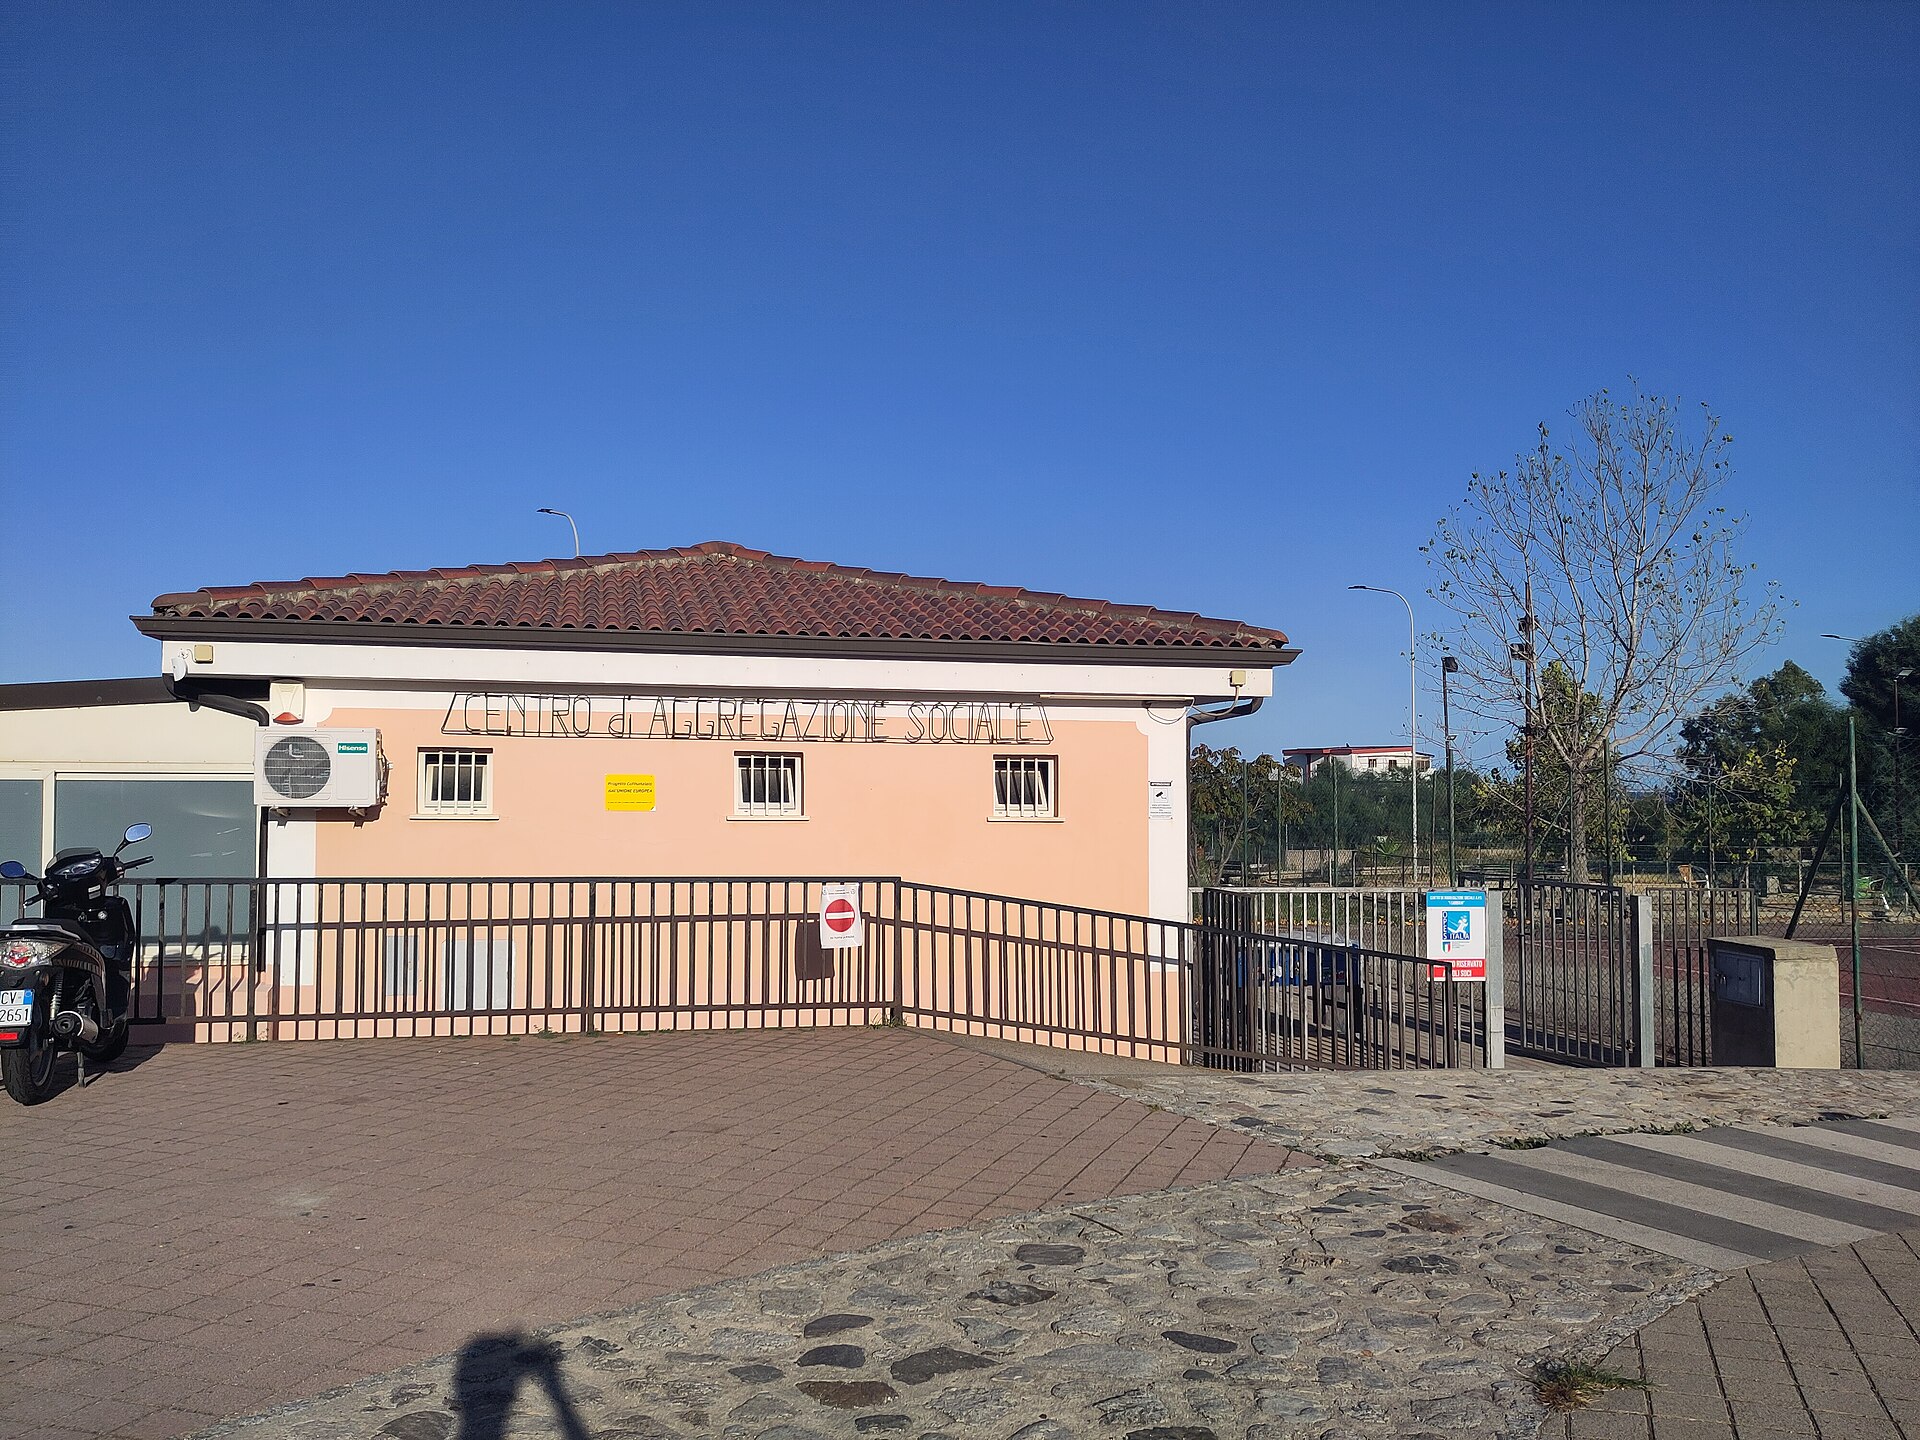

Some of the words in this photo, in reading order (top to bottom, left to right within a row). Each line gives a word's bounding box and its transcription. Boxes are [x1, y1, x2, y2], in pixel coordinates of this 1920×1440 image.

[464, 692, 591, 737] CENTRO
[649, 695, 889, 743] AGGREGAZIONE
[905, 700, 1034, 745] SOCIALE
[1, 992, 17, 1004] CV
[0, 1008, 29, 1022] 2651
